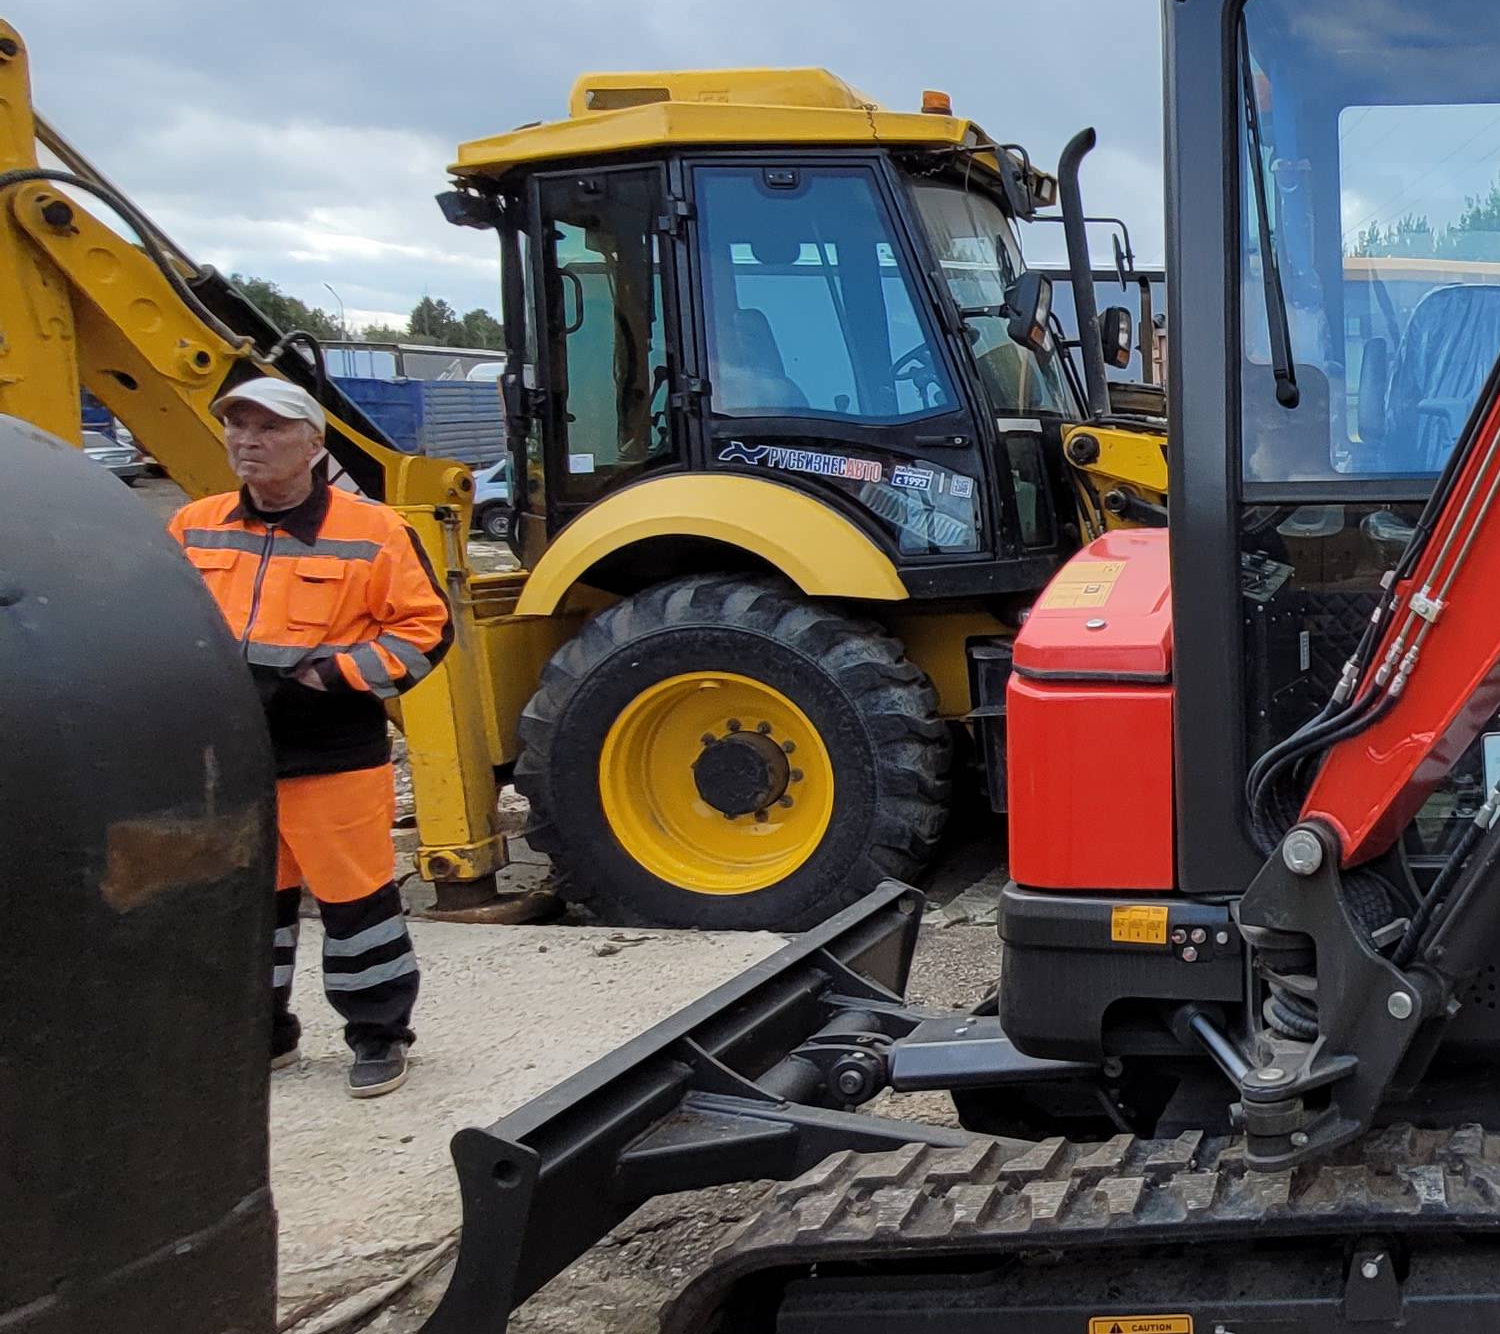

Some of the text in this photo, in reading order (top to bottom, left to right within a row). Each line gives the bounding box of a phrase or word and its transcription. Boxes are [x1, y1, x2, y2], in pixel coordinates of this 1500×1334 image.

[768, 447, 882, 482] РУСБИЗНЕСАВТО
[904, 476, 928, 487] 1993
[1131, 1323, 1172, 1332] CAUTION
